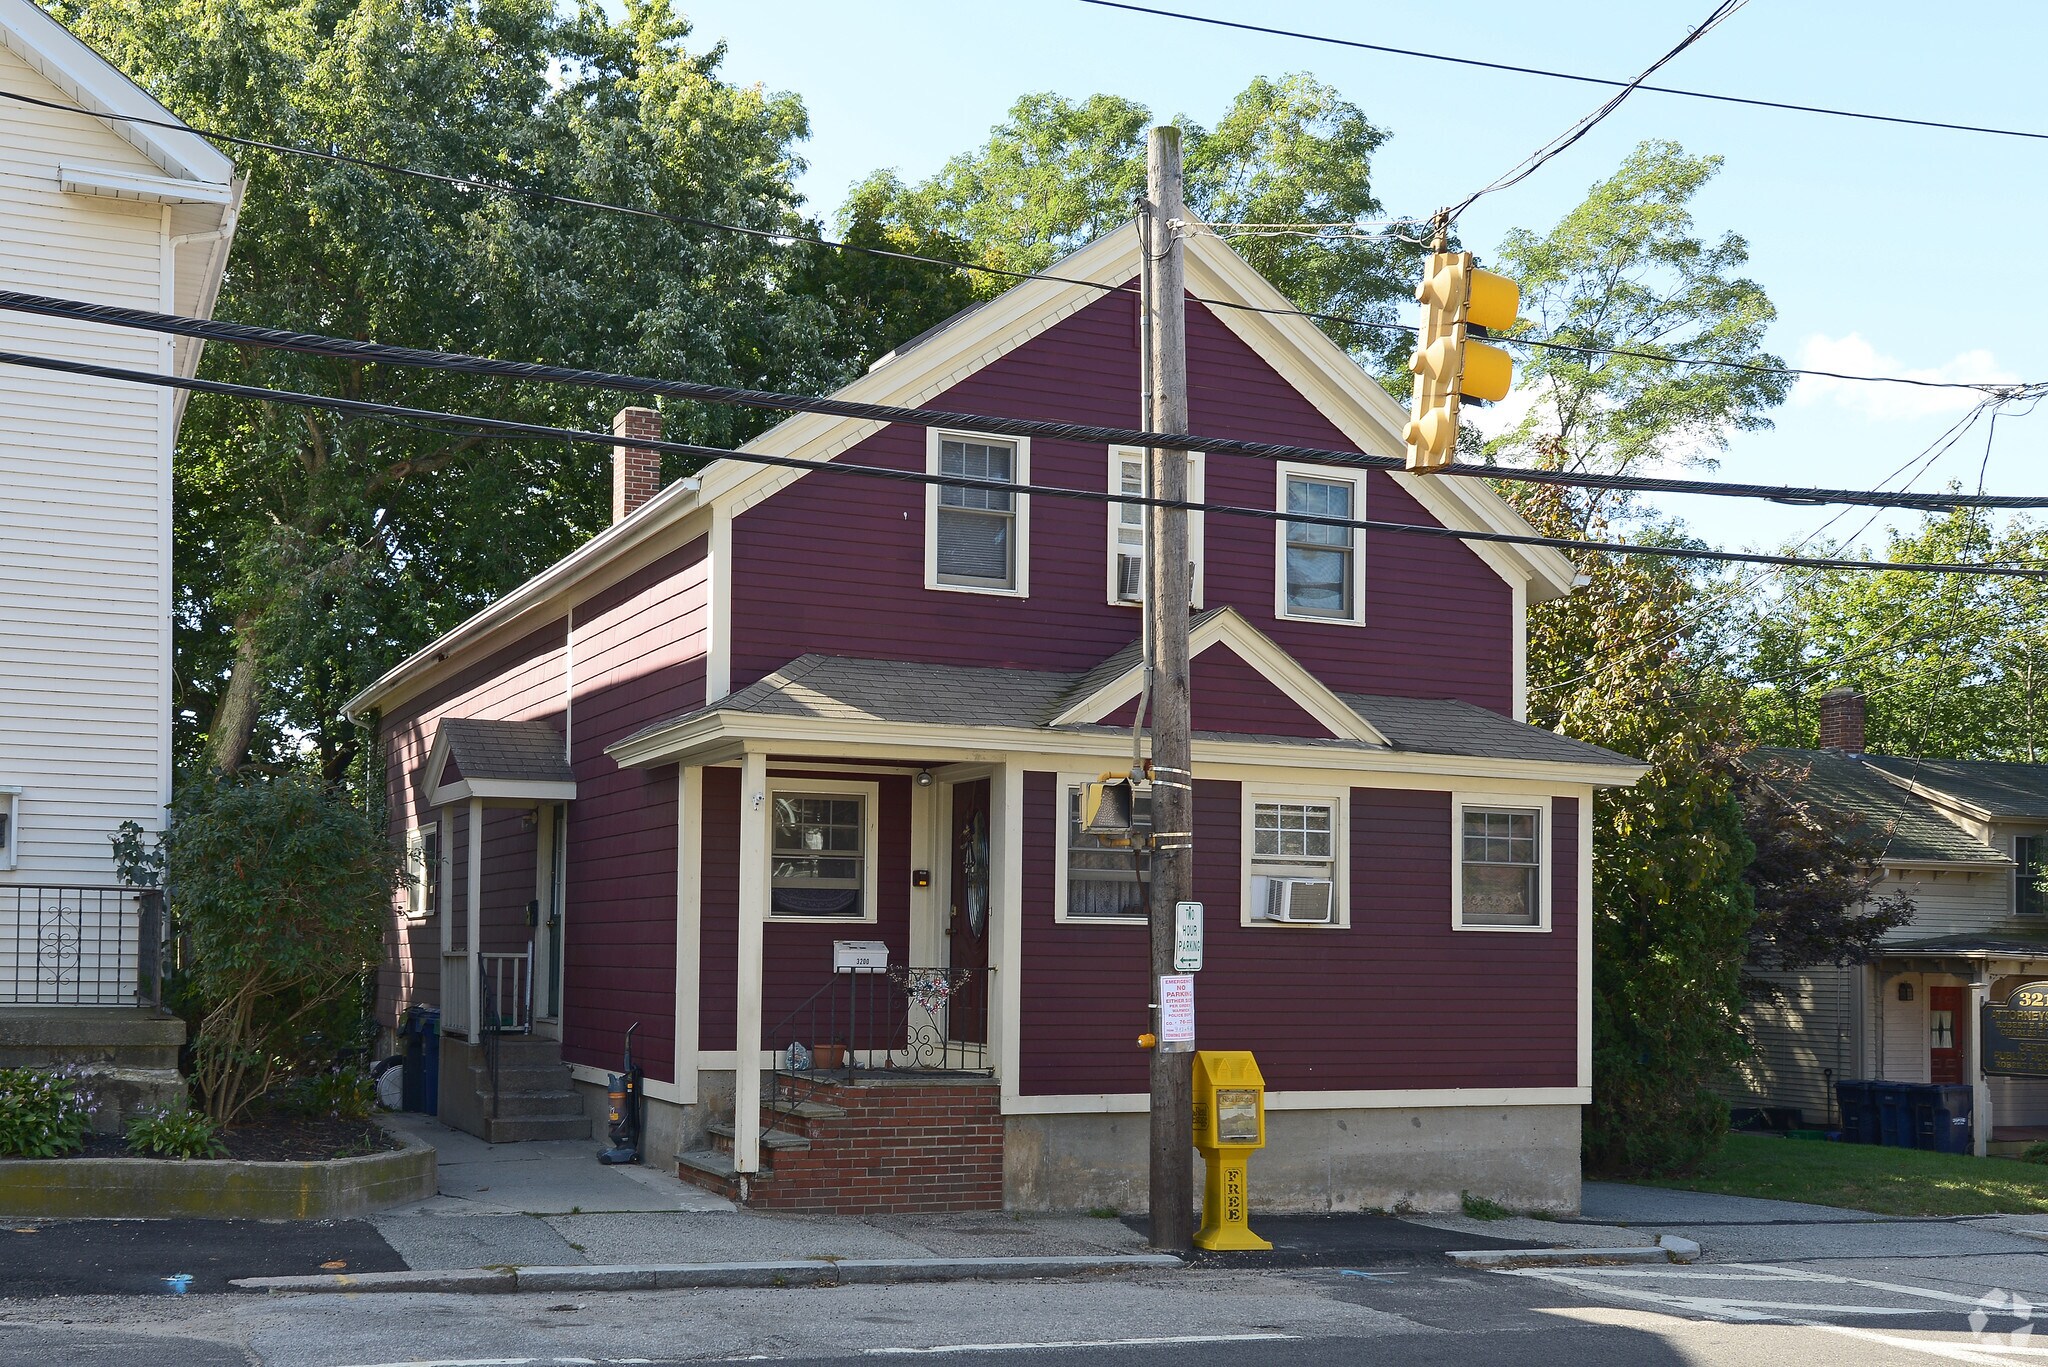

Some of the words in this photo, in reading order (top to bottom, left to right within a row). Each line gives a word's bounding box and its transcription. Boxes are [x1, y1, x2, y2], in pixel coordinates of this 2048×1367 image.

[1182, 925, 1198, 936] HOUR
[1178, 940, 1201, 951] PARKING
[1996, 1021, 2028, 1029] ROBERT
[1994, 1051, 2027, 1061] PUBLIC
[1227, 1170, 1240, 1220] FREE
